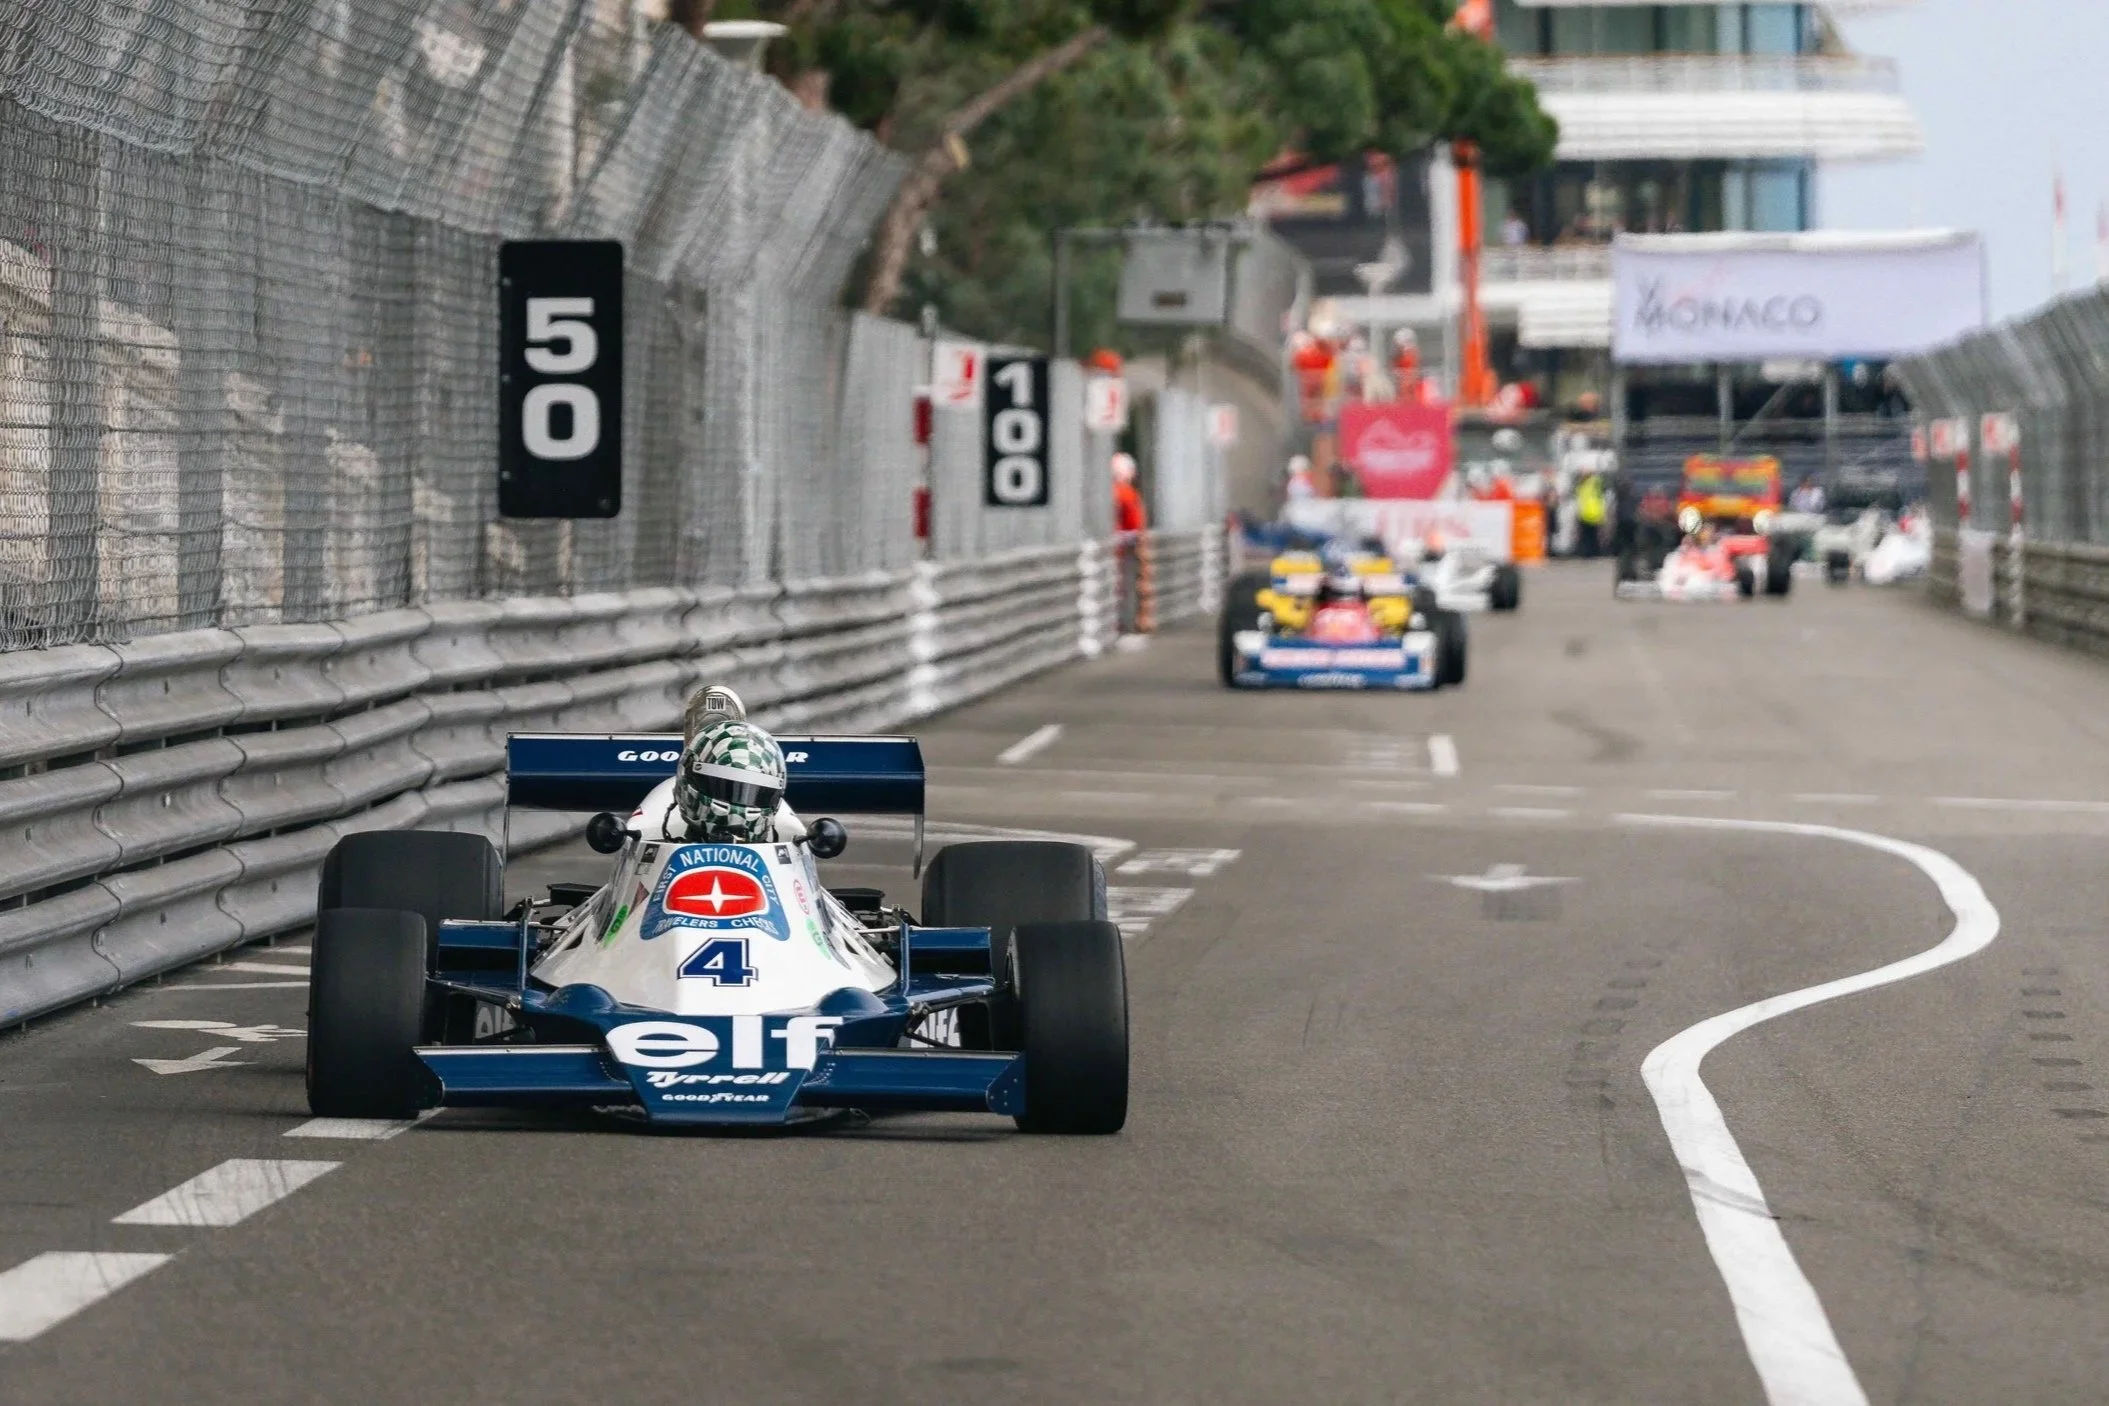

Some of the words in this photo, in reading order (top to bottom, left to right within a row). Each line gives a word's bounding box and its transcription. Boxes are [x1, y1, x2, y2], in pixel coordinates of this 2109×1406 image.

[522, 297, 600, 461] 50
[993, 361, 1042, 502] 100
[617, 750, 809, 763] GOOR
[652, 864, 677, 902] FIRST
[679, 847, 760, 873] NATIONAL
[761, 874, 780, 905] CITY
[677, 938, 758, 987] 4
[606, 1015, 844, 1073] elf
[646, 1071, 791, 1088] Tyrrell
[661, 1092, 770, 1103] GOODYEAR
